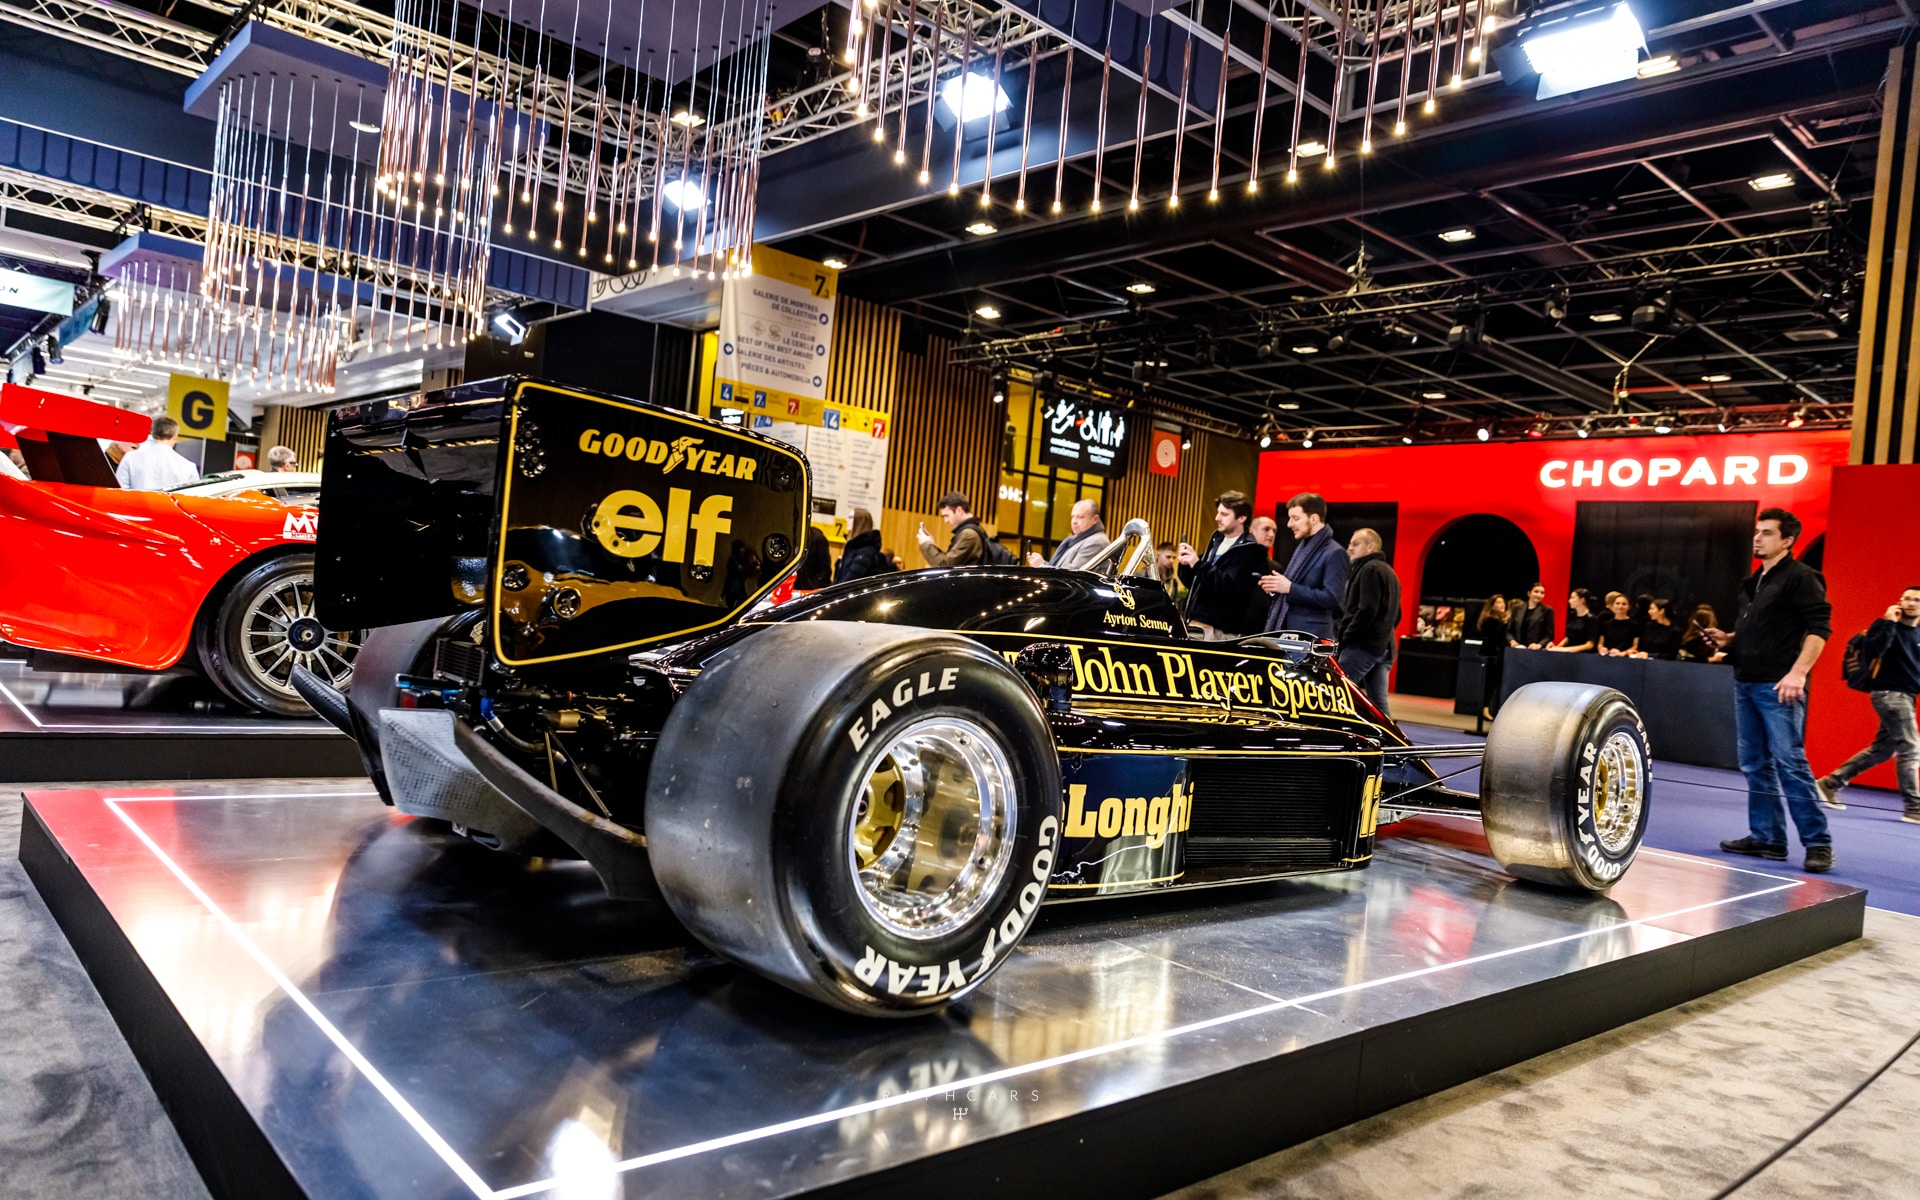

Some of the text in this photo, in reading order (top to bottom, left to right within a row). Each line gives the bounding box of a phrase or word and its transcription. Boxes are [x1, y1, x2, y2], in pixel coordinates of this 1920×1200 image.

[753, 289, 818, 313] GALERIE DE MONTRES
[771, 302, 818, 321] DE COLLECTION
[737, 335, 753, 345] BEST
[764, 342, 775, 351] THE
[777, 345, 792, 354] BEST
[764, 354, 776, 363] DES
[771, 369, 811, 384] AUTOMOBILIA
[181, 390, 215, 430] G
[1540, 454, 1809, 488] CHOPARD
[592, 487, 733, 567] elf
[1103, 610, 1169, 631] Ayrton Senna
[1067, 644, 1357, 719] John Player Special
[848, 667, 960, 752] EAGLE
[1061, 781, 1195, 849] Longhi
